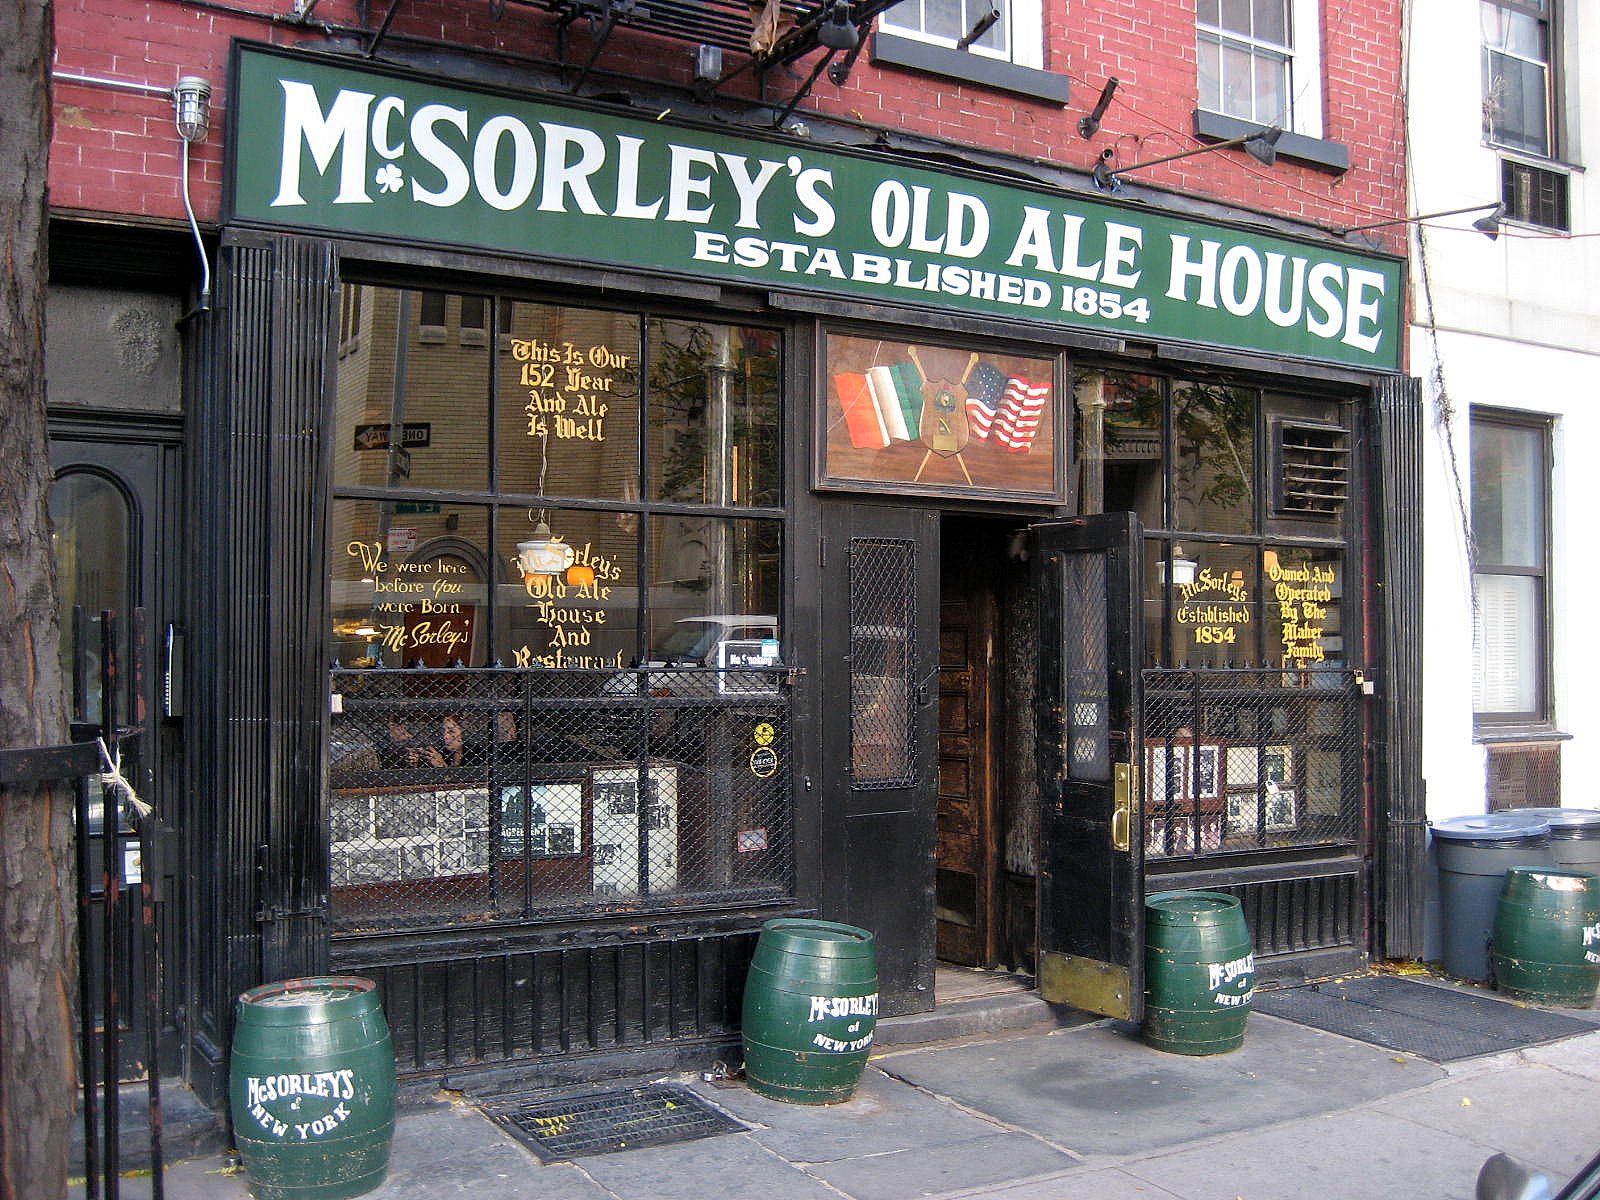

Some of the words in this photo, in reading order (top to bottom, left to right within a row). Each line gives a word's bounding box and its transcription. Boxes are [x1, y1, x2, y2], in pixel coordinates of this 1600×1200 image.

[692, 230, 1053, 308] ESTABLISHED
[1061, 284, 1151, 324] 1854
[870, 178, 991, 259] OLD
[1005, 206, 1145, 288] ALE
[1165, 232, 1387, 354] HOUSE
[511, 338, 561, 362] This
[562, 341, 585, 366] Is
[588, 344, 631, 369] Our
[520, 363, 555, 388] 152
[564, 365, 613, 392] Year
[525, 389, 566, 414] And
[572, 394, 608, 418] Ale
[526, 412, 549, 437] Is
[553, 414, 606, 441] Well
[347, 541, 388, 573] We
[395, 561, 432, 573] were
[438, 559, 468, 574] here
[375, 576, 425, 593] before
[1269, 561, 1310, 582] Owned
[1311, 564, 1335, 584] And
[526, 574, 566, 599] Old
[575, 577, 612, 600] Ale
[1275, 582, 1331, 605] Operated
[379, 602, 415, 613] were
[526, 600, 607, 628] House
[1177, 605, 1250, 623] Established
[1280, 600, 1299, 624] By
[1302, 601, 1327, 620] The
[549, 624, 591, 648] And
[1195, 625, 1237, 644] 1854
[1281, 621, 1324, 645] Maher
[730, 653, 741, 665] No
[1282, 642, 1325, 663] Family
[1214, 992, 1242, 1006] NEW
[847, 1021, 860, 1033] of
[812, 1033, 848, 1052] NEW
[251, 1103, 289, 1137] NEW
[295, 1101, 351, 1139] YORK
